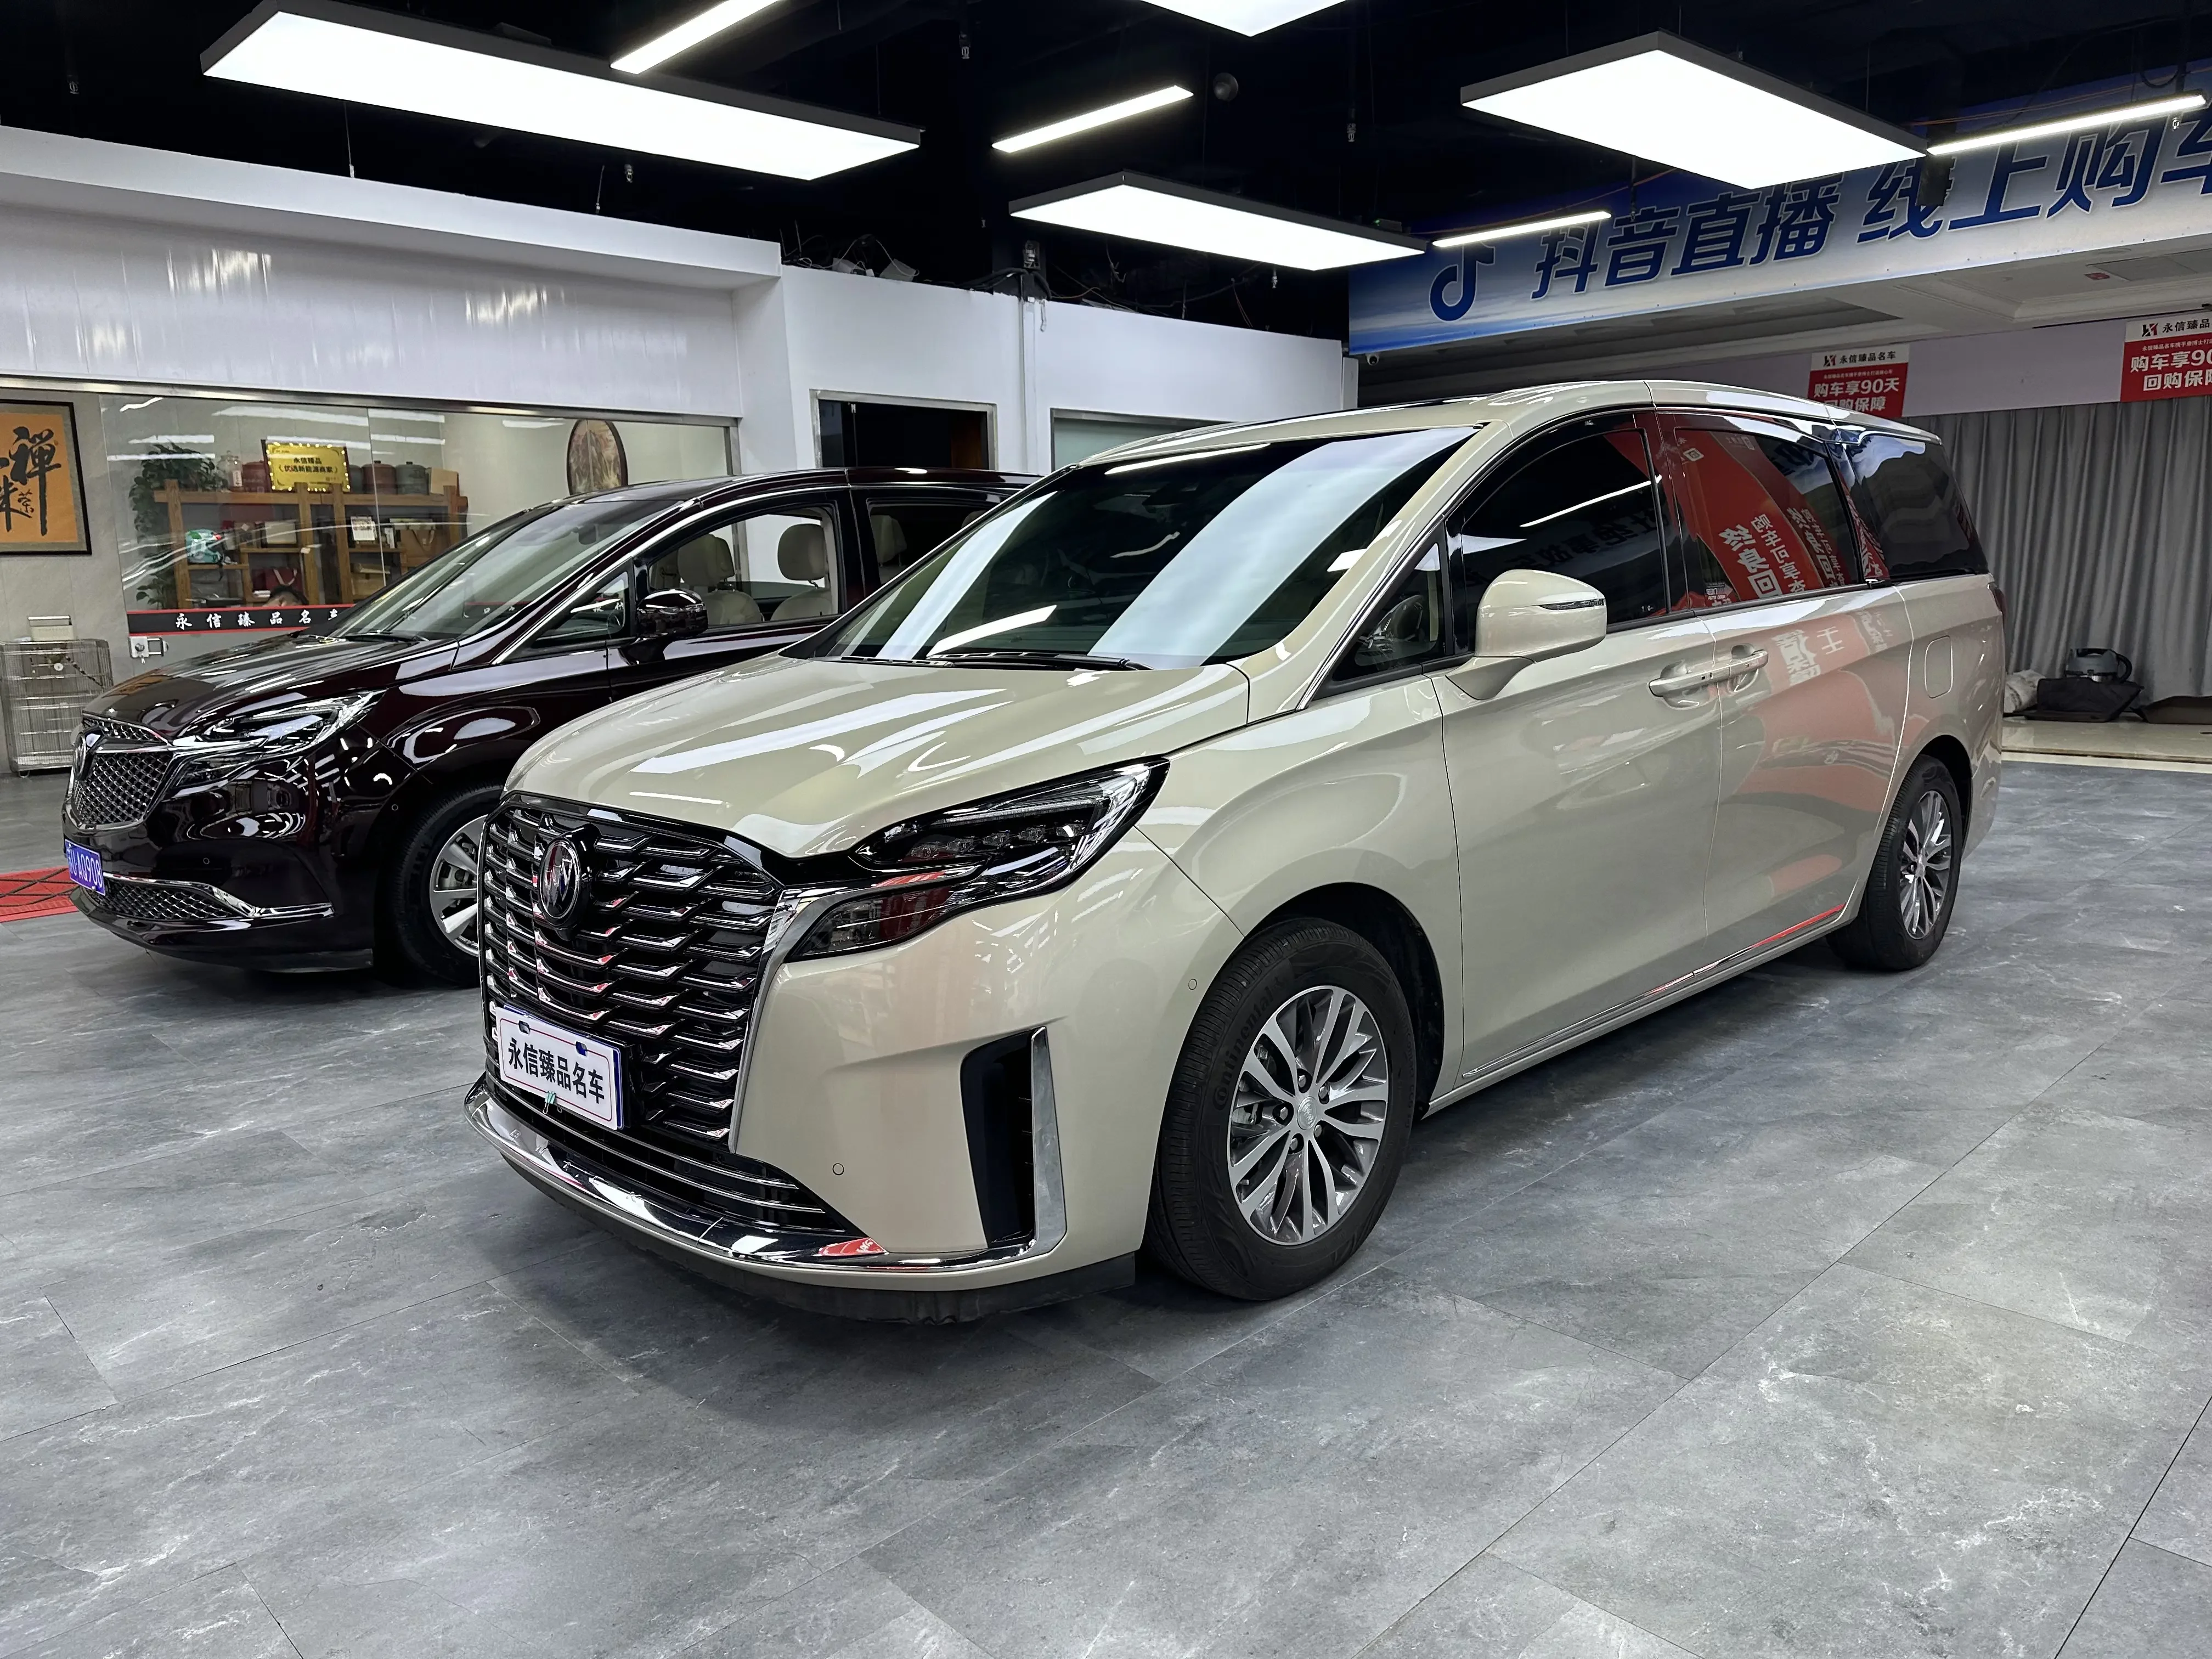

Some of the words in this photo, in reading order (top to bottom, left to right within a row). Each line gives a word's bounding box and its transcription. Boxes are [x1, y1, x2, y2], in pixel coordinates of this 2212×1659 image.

[1530, 173, 1844, 301] 抖音直播
[2162, 318, 2212, 333] 永信臻品
[1839, 351, 1896, 364] 永信臻品名车
[1814, 377, 1900, 398] 购车享90天
[508, 1036, 605, 1104] 永信臻品名车
[1212, 985, 1274, 1111] Continental
